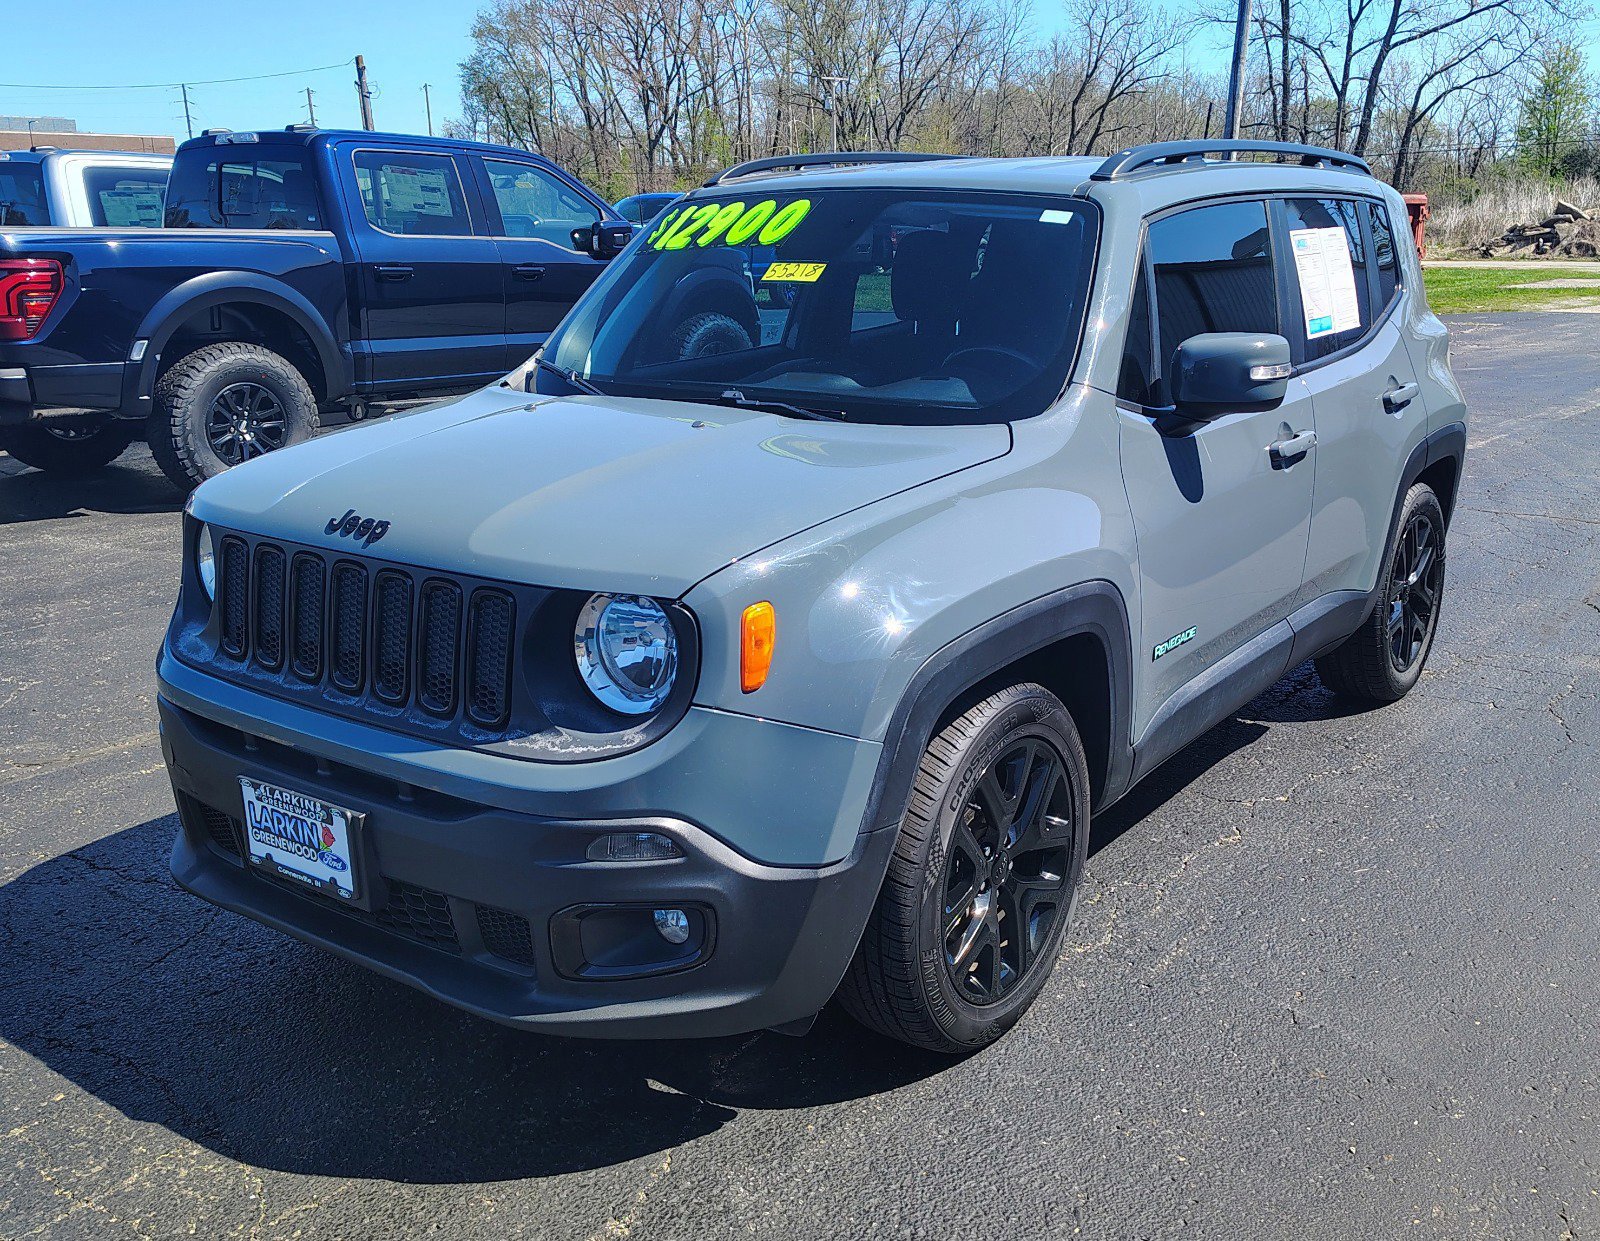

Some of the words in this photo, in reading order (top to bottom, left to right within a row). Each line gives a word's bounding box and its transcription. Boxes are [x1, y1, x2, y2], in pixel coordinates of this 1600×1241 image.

[766, 263, 823, 279] 55218
[324, 509, 391, 549] Jeep
[1152, 625, 1197, 662] RENEGADE
[248, 801, 321, 850] LARKIN
[261, 795, 323, 822] GREENEWOOD
[251, 829, 318, 863] GREENEWOOD
[322, 852, 343, 870] Ford
